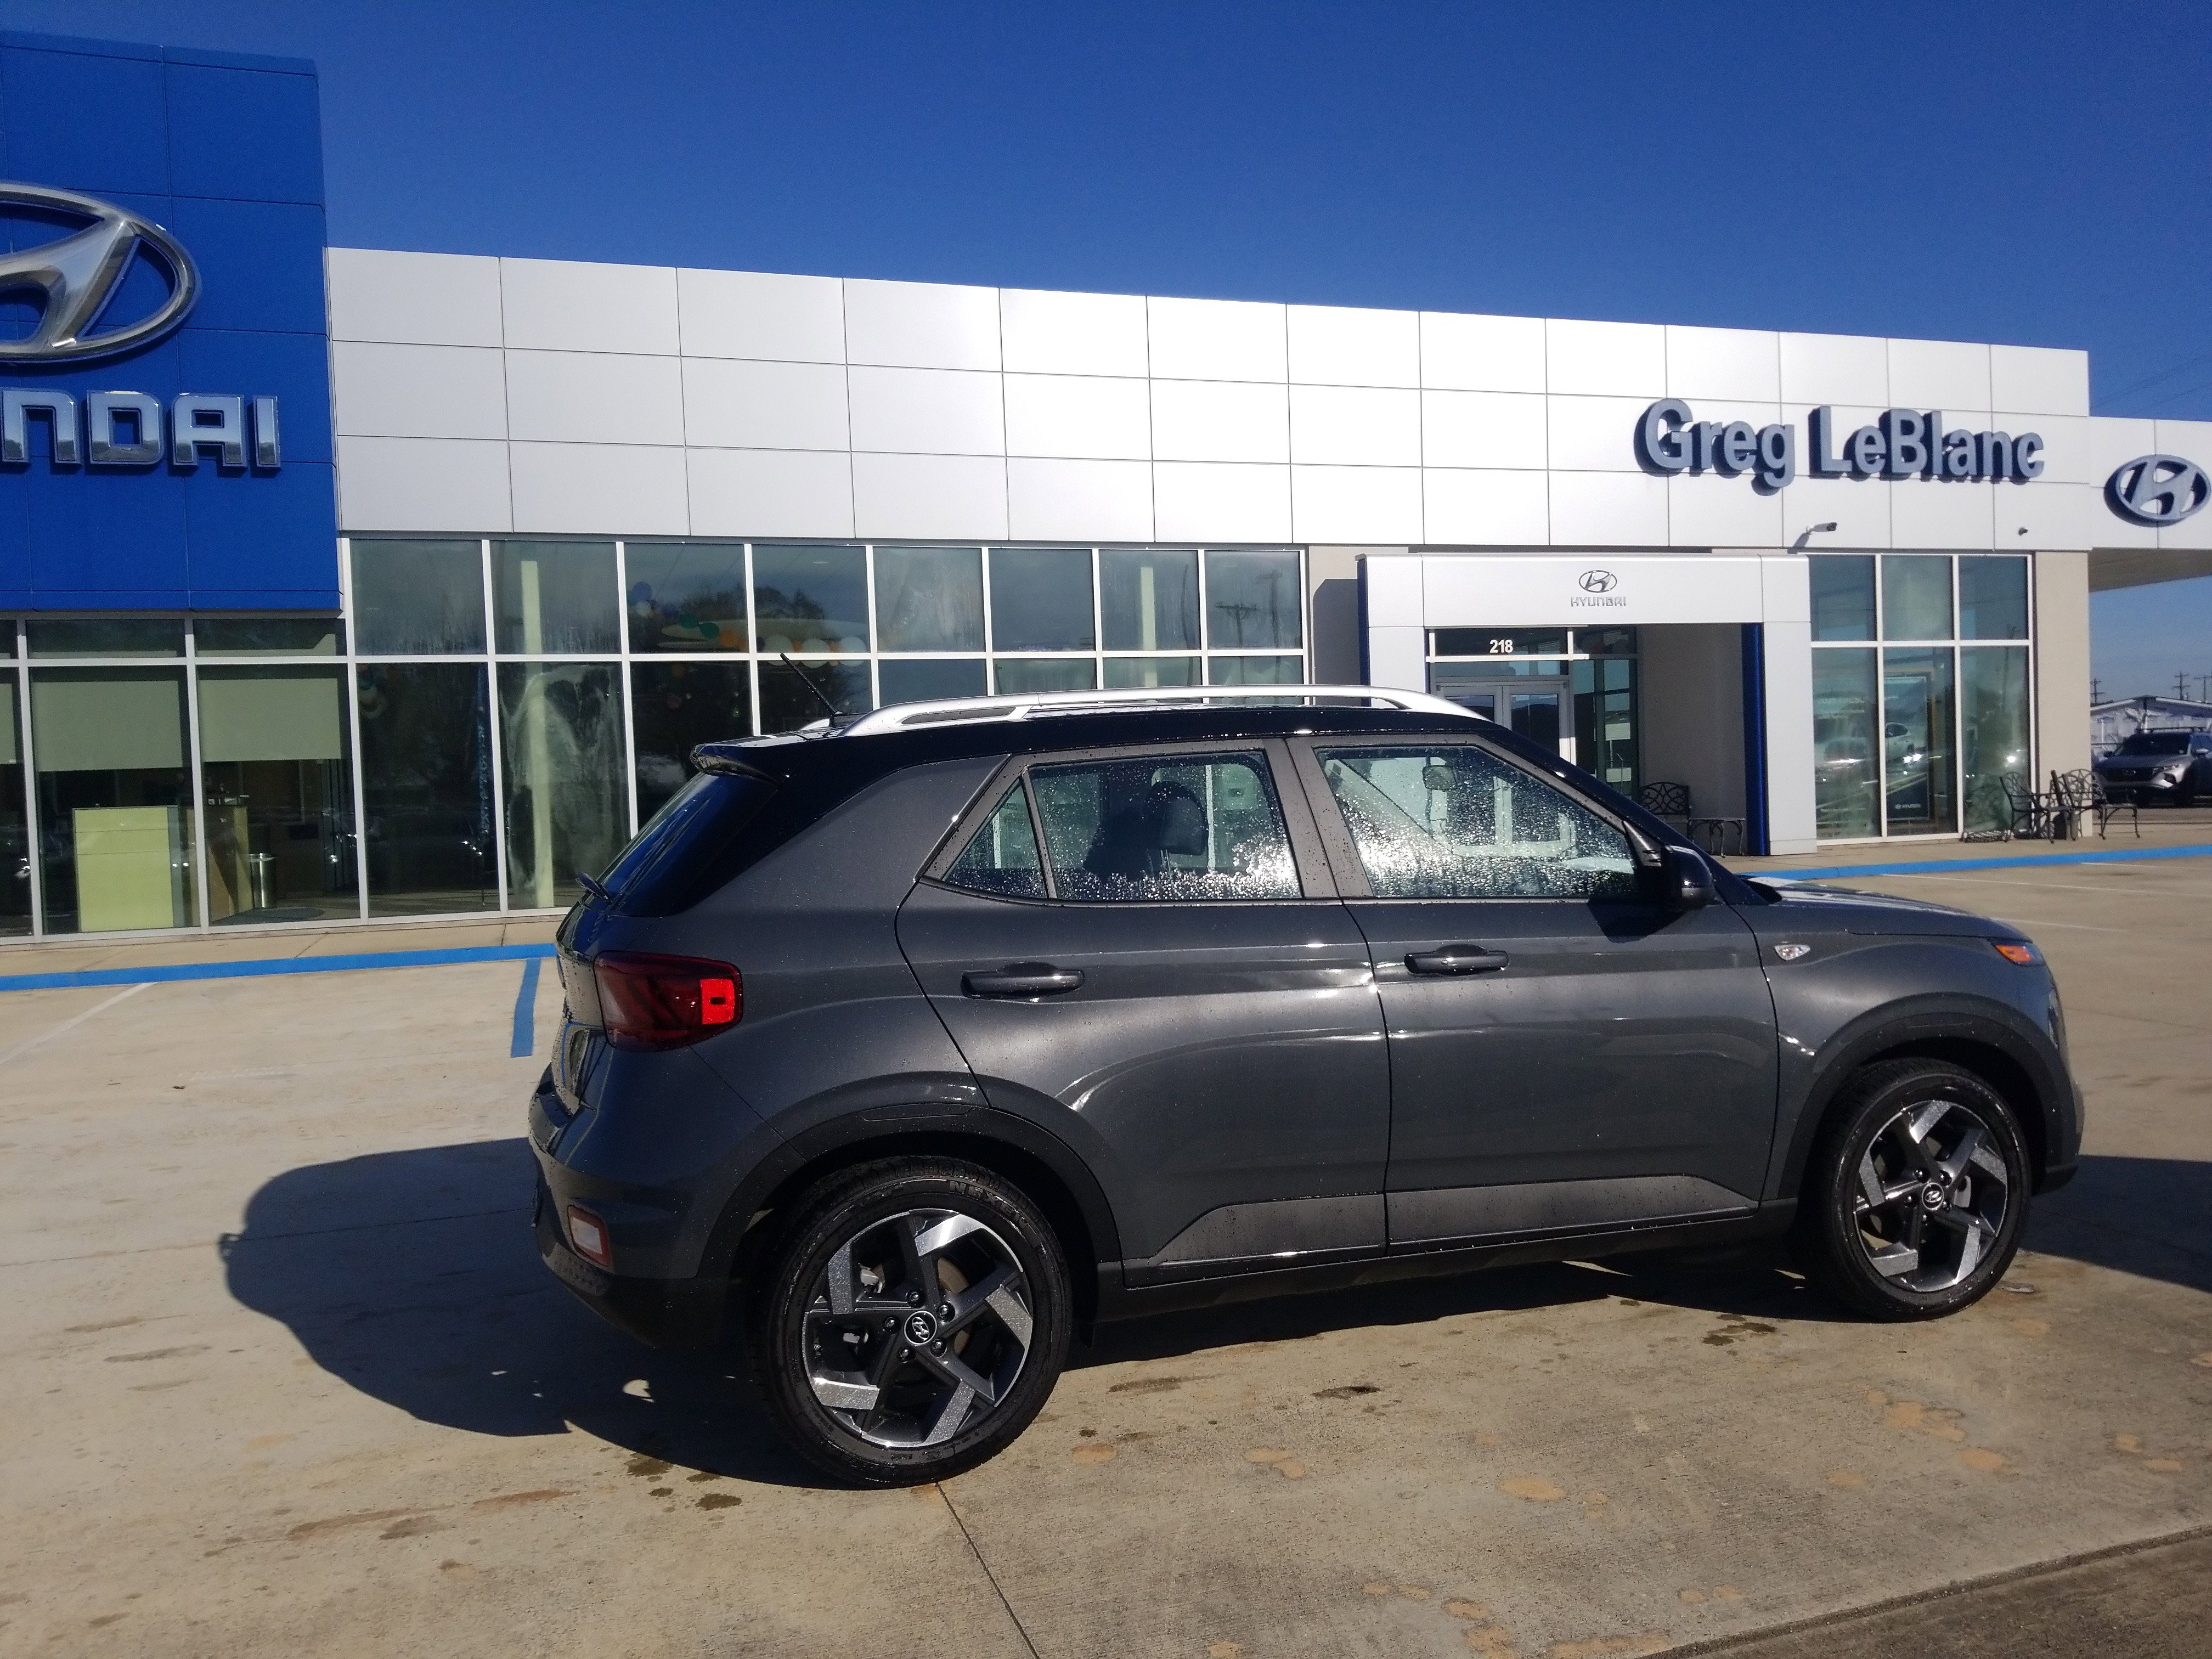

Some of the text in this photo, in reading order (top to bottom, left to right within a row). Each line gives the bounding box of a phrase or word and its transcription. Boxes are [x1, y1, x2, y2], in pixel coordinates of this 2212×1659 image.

[1636, 398, 2045, 494] Greg LeBlanc
[1570, 596, 1627, 607] HYUNDAI
[1489, 639, 1514, 654] 218
[950, 1181, 1029, 1230] NEXEN
